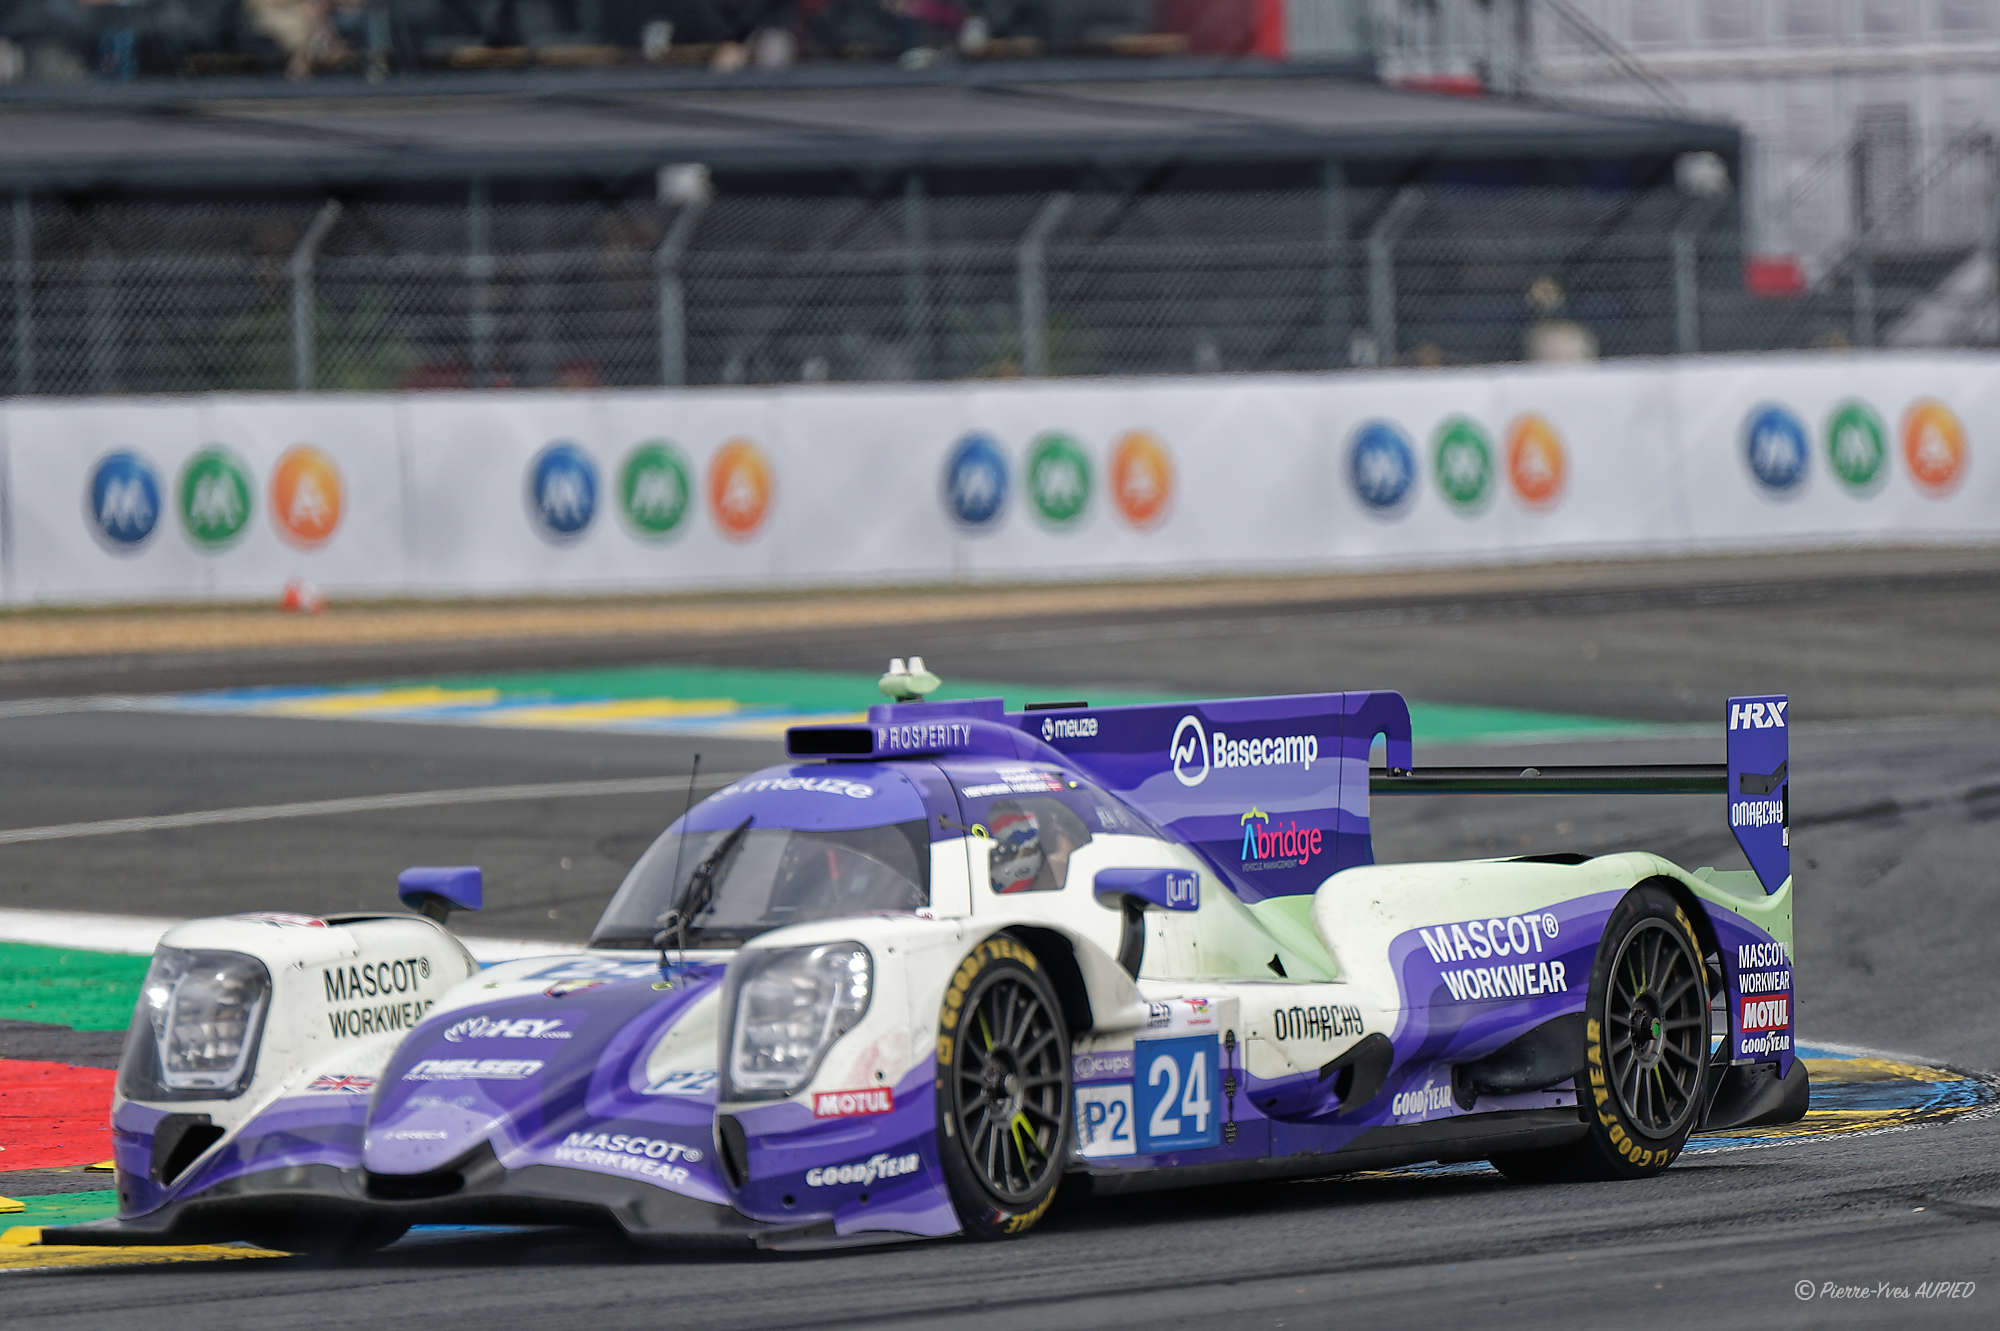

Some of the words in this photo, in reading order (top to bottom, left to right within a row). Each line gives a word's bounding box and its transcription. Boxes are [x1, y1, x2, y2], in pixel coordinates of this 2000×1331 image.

[1055, 718, 1099, 738] meuze
[1730, 702, 1787, 730] HRX
[878, 724, 970, 750] PROSPERITY
[1212, 732, 1318, 770] Basecamp
[1732, 800, 1784, 828] OMARCHY
[1440, 961, 1568, 1001] WORKWEAR
[1738, 970, 1790, 994] WORKWEAR
[1274, 1005, 1364, 1042] OMARCHY
[1742, 1000, 1789, 1029] MOTUL
[1741, 1030, 1790, 1056] GOODYEAR
[652, 1071, 717, 1090] P2
[1148, 1051, 1211, 1137] 24
[817, 1091, 892, 1116] MOTUL
[1393, 1079, 1451, 1118] GOODYEAR
[1085, 1100, 1129, 1144] P2
[554, 1147, 689, 1185] WORKWEAR
[805, 1152, 920, 1188] GOODYEAR
